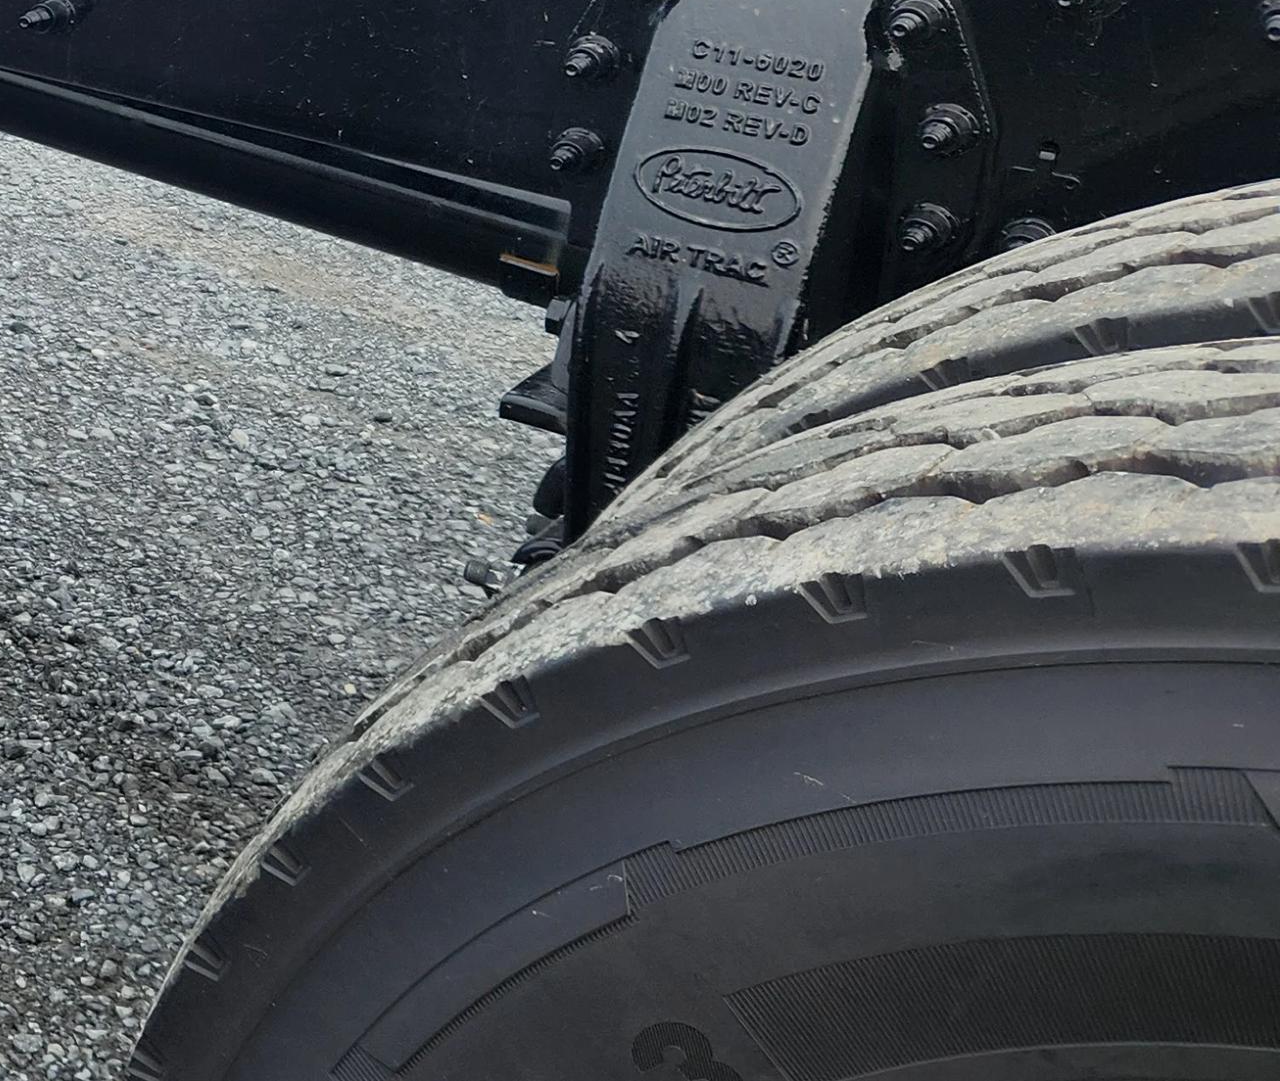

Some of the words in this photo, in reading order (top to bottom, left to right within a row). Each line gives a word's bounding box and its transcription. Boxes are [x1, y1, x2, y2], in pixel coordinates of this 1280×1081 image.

[692, 38, 825, 82] C11-6020
[733, 80, 822, 115] REV-C
[722, 110, 808, 147] REV-D
[651, 156, 782, 215] Peterbilt
[626, 233, 681, 264] AIR
[686, 244, 768, 286] TRAC
